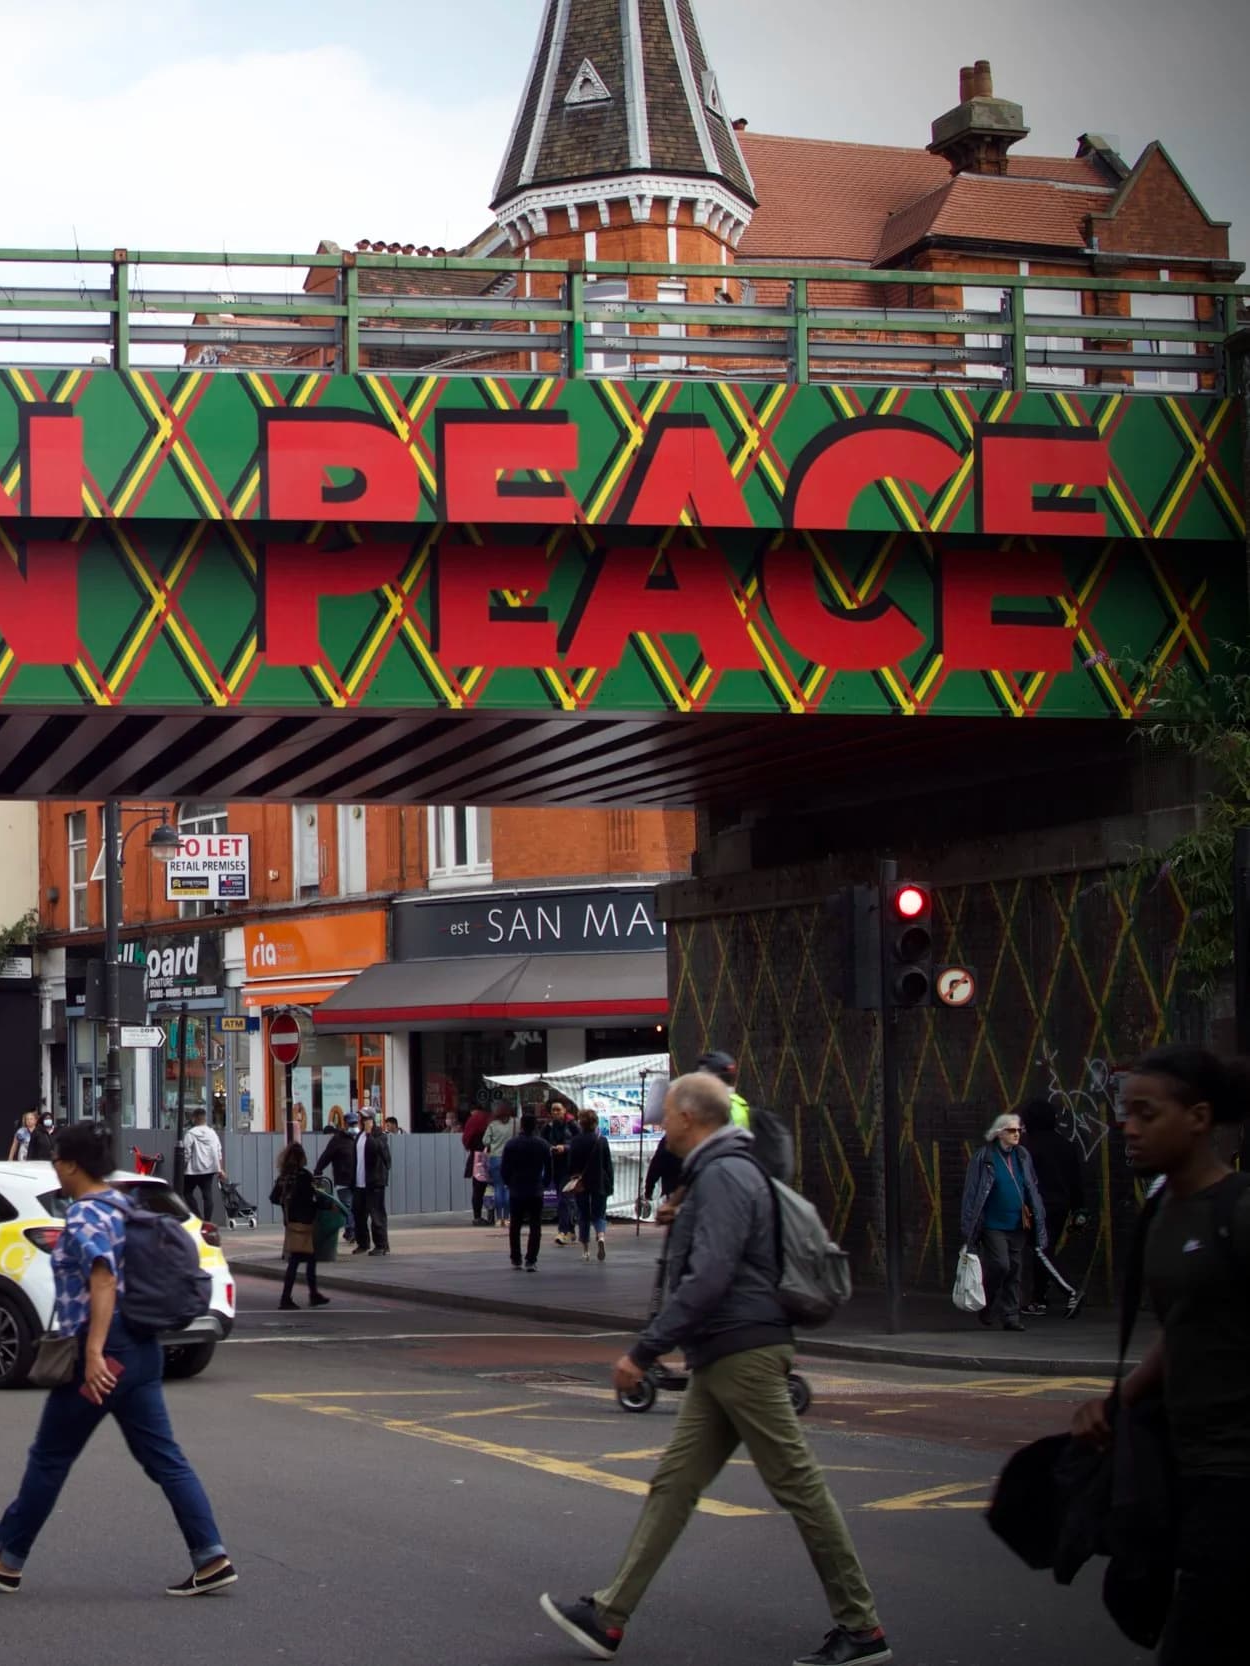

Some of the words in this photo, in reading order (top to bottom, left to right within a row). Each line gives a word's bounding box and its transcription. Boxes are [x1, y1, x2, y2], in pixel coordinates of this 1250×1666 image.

[260, 408, 1111, 673] PEACE
[207, 838, 243, 857] LET
[170, 860, 200, 871] RETAIL
[202, 860, 246, 871] PREMISES
[450, 920, 470, 936] est
[487, 905, 561, 943] SAN
[582, 902, 667, 938] MA
[117, 935, 200, 978] illboard
[252, 931, 277, 967] ria
[150, 977, 174, 987] RNITURE
[223, 1019, 245, 1029] ATM
